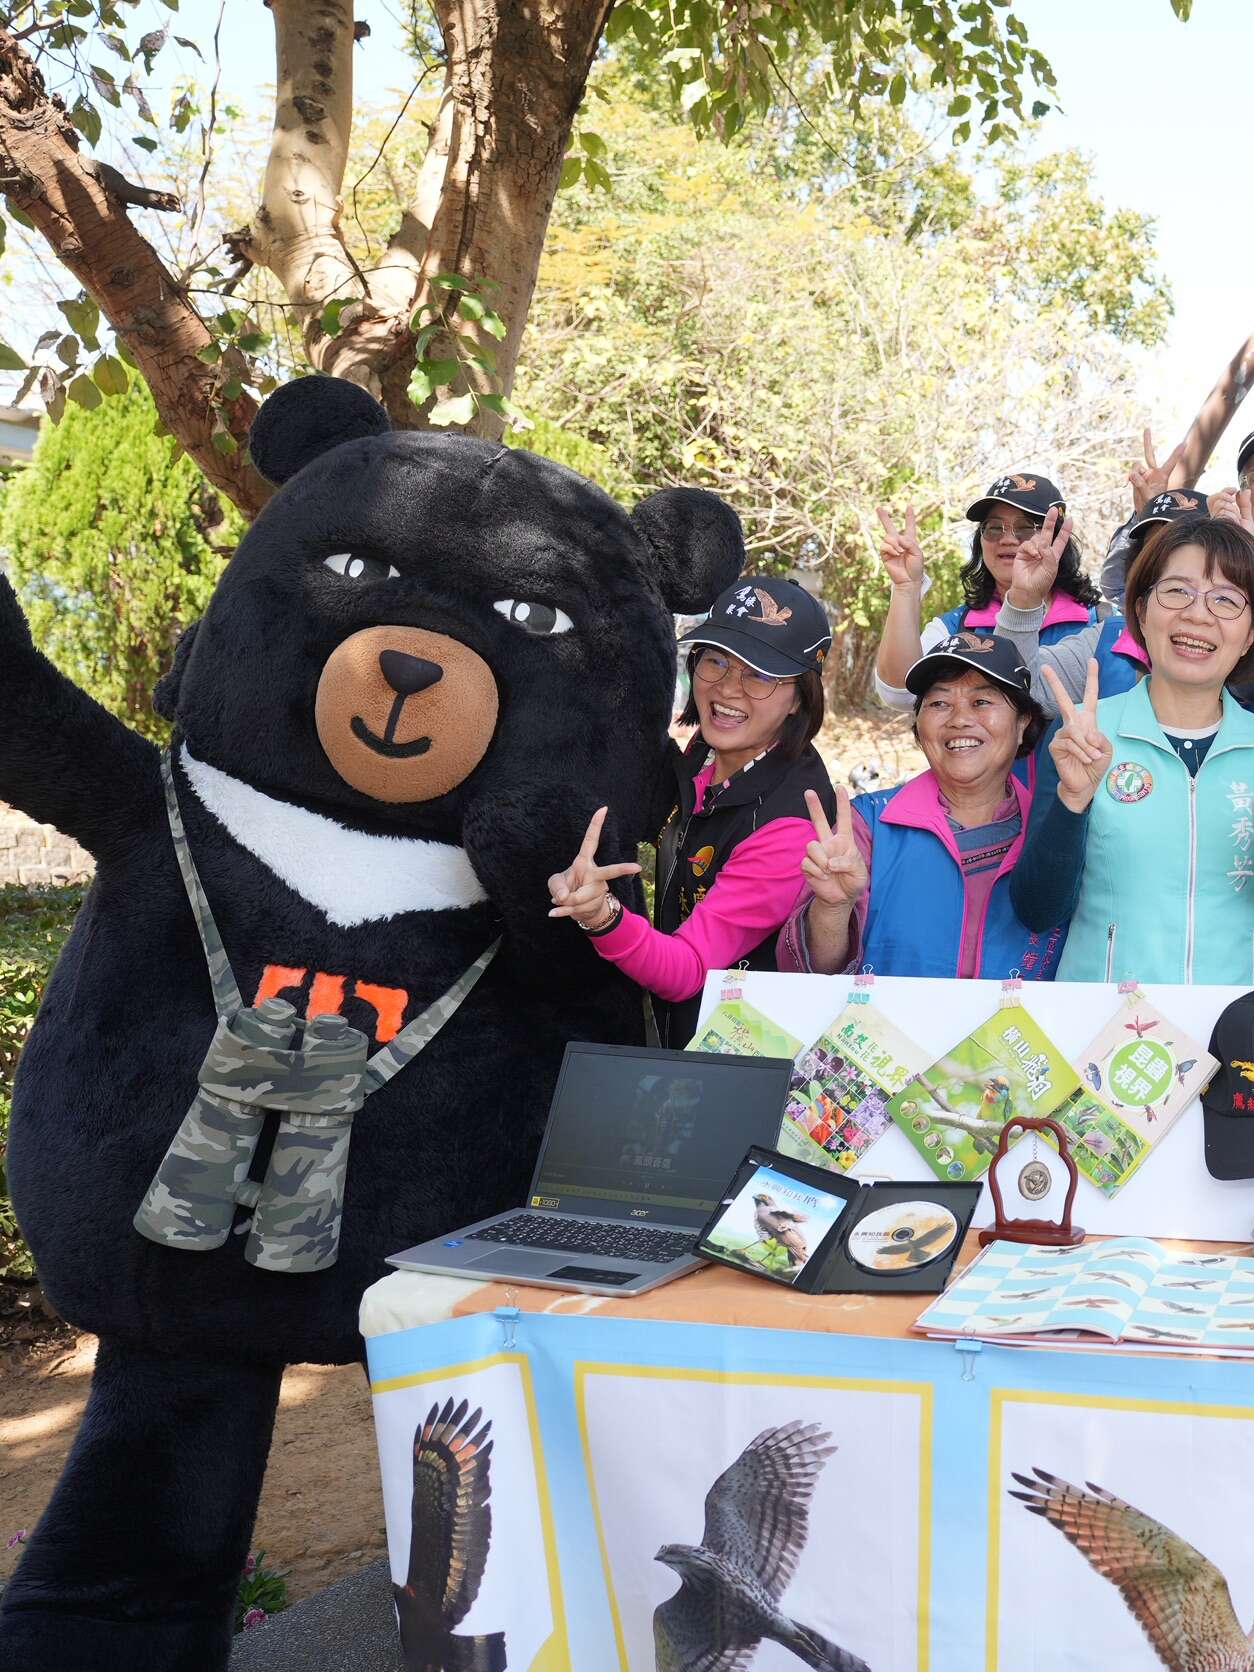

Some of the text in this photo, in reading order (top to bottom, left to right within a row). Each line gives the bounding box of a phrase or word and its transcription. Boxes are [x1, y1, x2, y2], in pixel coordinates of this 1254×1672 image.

[1226, 781, 1254, 893] 黃秀芳
[1112, 1063, 1153, 1101] 視界
[1128, 1043, 1169, 1083] 昆蟲
[630, 1209, 649, 1217] acer
